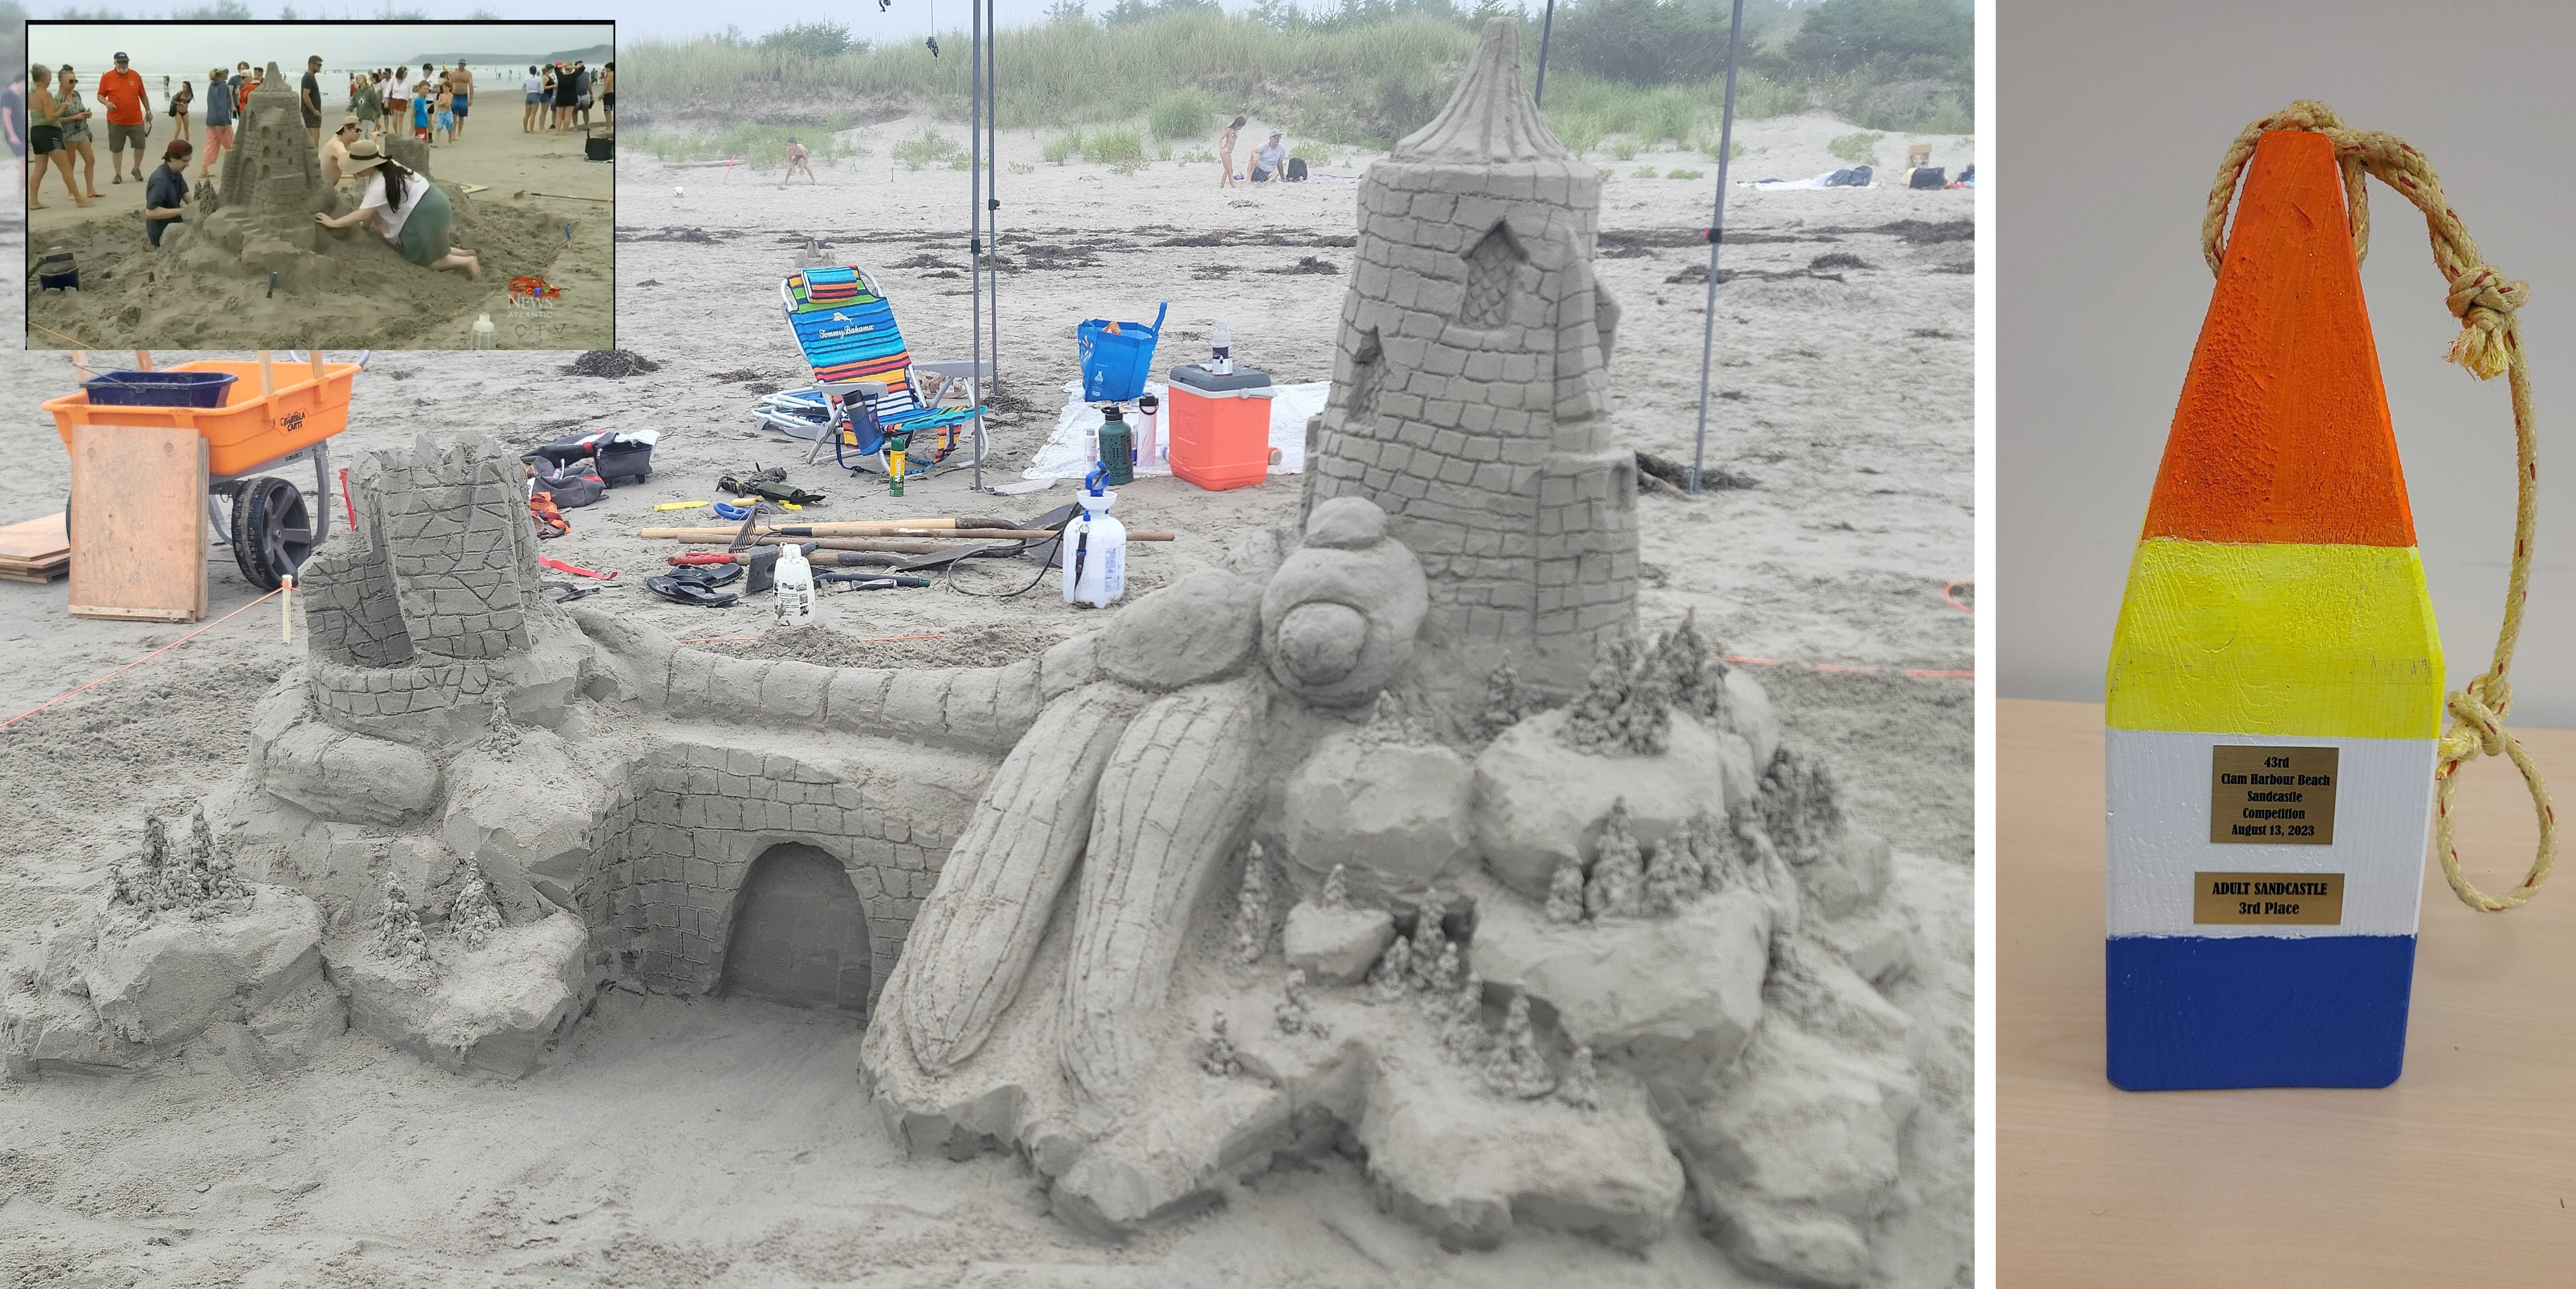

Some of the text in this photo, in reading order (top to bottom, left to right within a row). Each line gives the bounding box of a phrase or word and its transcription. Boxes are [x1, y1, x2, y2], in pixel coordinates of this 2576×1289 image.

[819, 325, 874, 339] Tommy Bahama
[2264, 756, 2290, 768] 43rd
[2221, 773, 2330, 786] Clam Harbour Beach
[2247, 791, 2303, 802] Sandcastle
[2243, 808, 2305, 820] Competition
[2231, 825, 2314, 837] August 13, 2023
[2212, 882, 2328, 895] ADULT SANDCASTLE
[2239, 901, 2300, 914] 3rd Place
